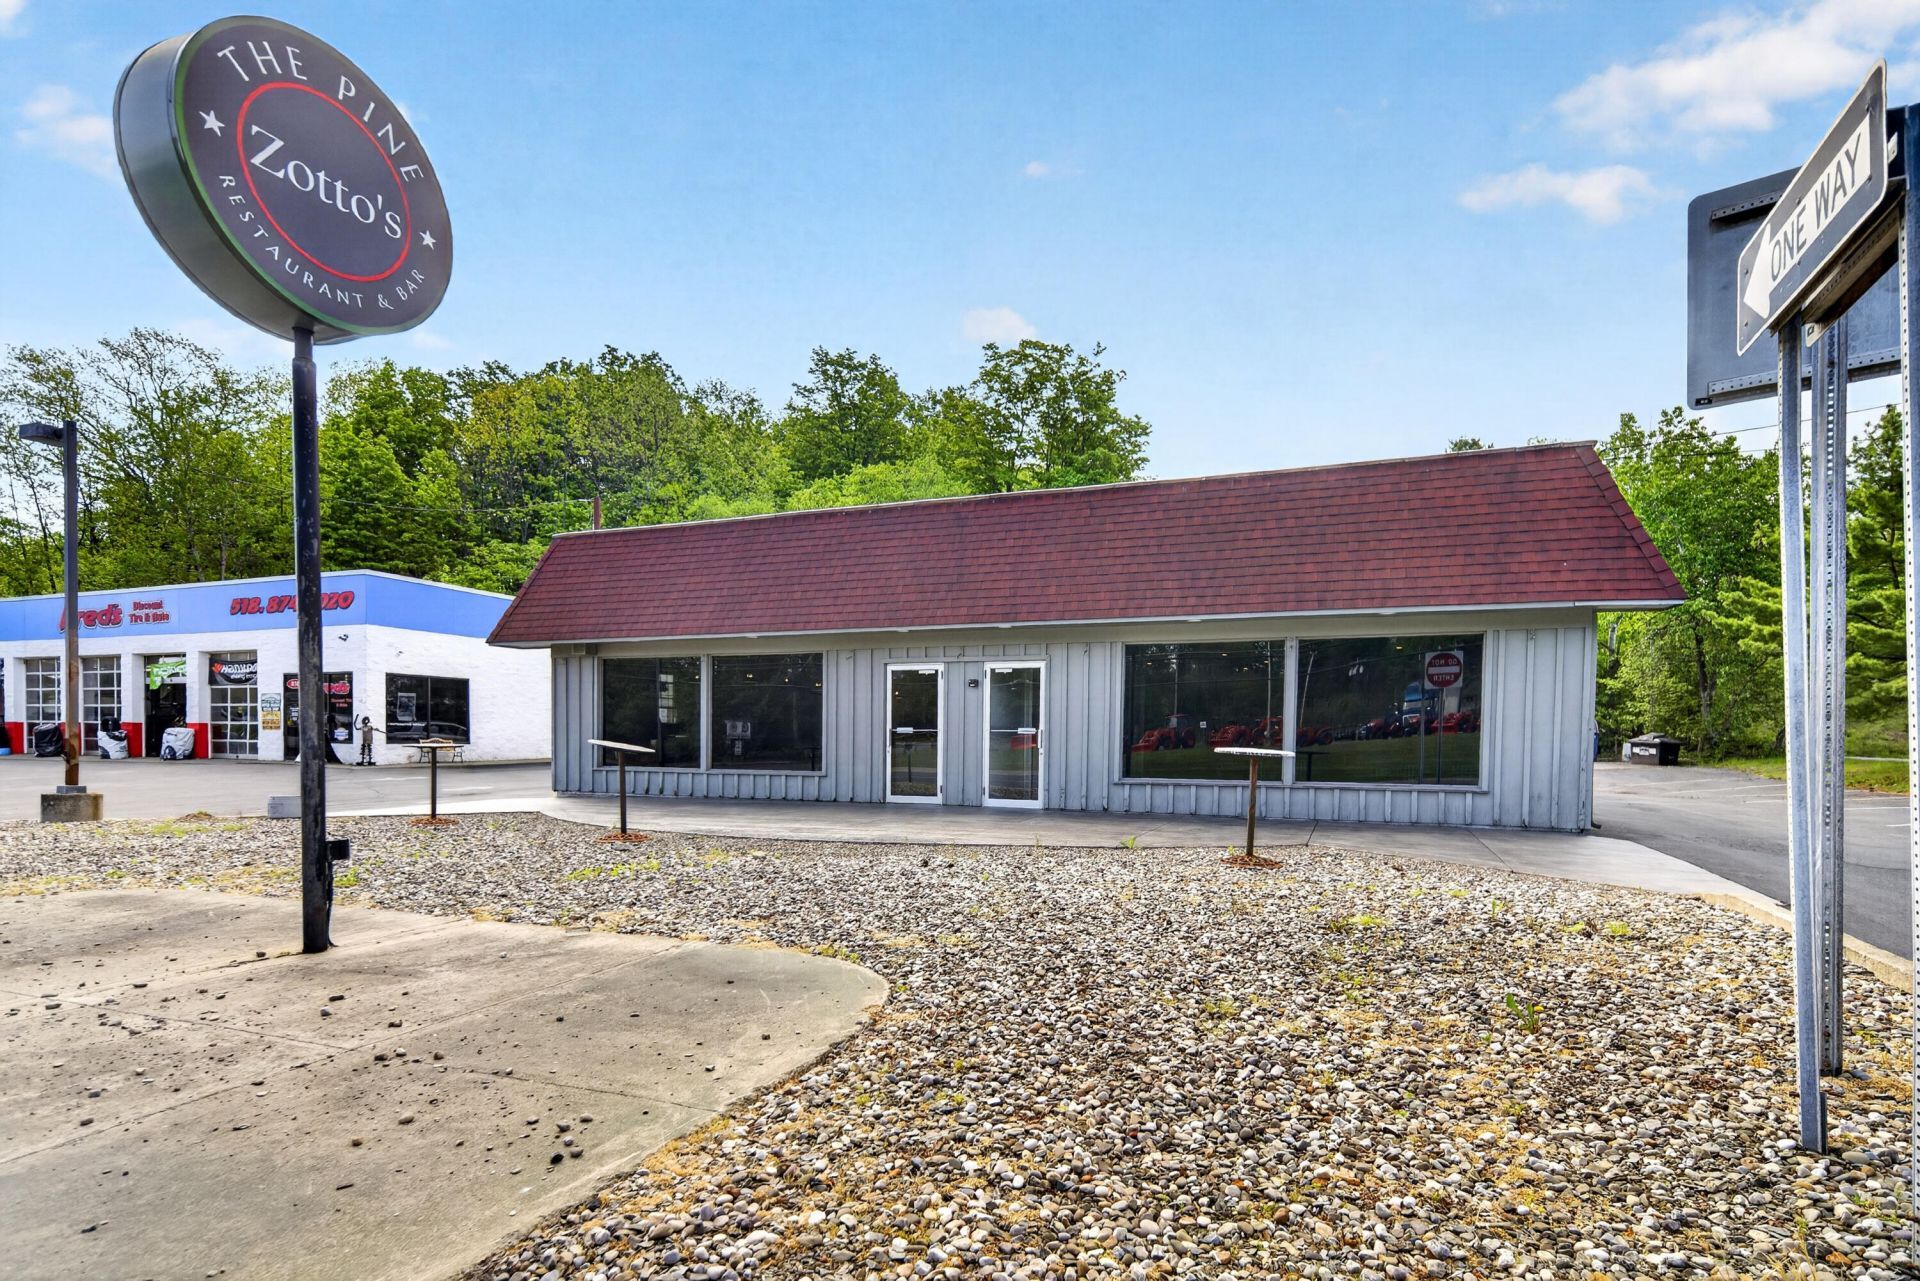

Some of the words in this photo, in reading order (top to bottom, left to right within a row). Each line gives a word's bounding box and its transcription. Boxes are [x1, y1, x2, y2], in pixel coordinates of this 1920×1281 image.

[217, 41, 307, 81] THE
[338, 75, 424, 183] PINE
[218, 174, 364, 308] RESTAURANT
[377, 293, 395, 310] &
[397, 268, 425, 302] BAR
[250, 124, 402, 240] Zotto's
[1770, 203, 1807, 283] ONE
[1814, 131, 1862, 230] WAY
